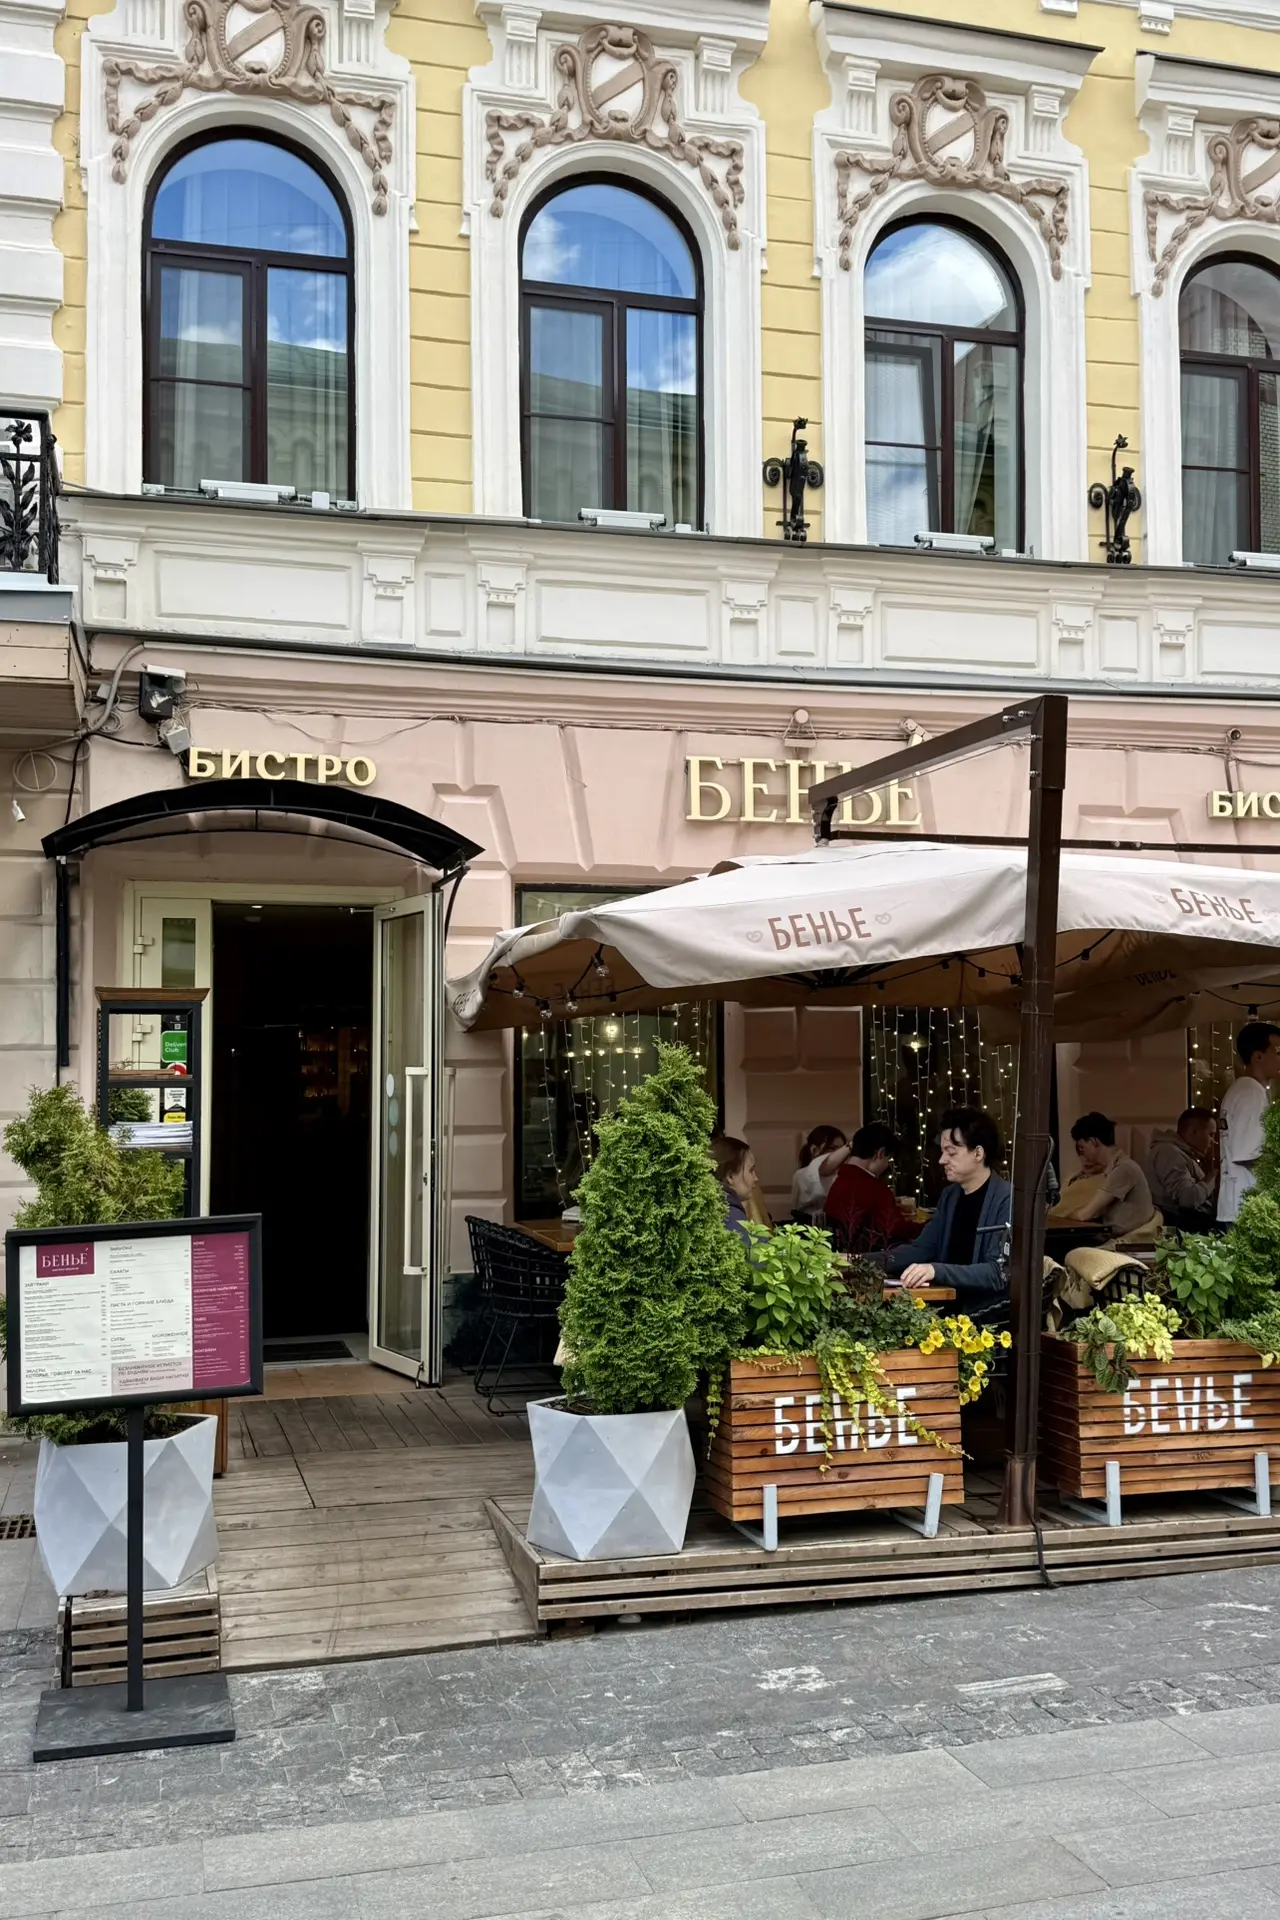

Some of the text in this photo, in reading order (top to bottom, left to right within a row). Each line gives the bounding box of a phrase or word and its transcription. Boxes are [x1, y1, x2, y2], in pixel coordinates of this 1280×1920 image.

[189, 747, 377, 786] БИСТРО
[1212, 790, 1280, 818] БИС
[1170, 888, 1263, 924] БЕНЬЕ
[767, 907, 872, 951] БЕНЬЕ
[774, 1387, 918, 1455] БЕНЬЕ
[1123, 1374, 1255, 1435] БЕНЬЕ
